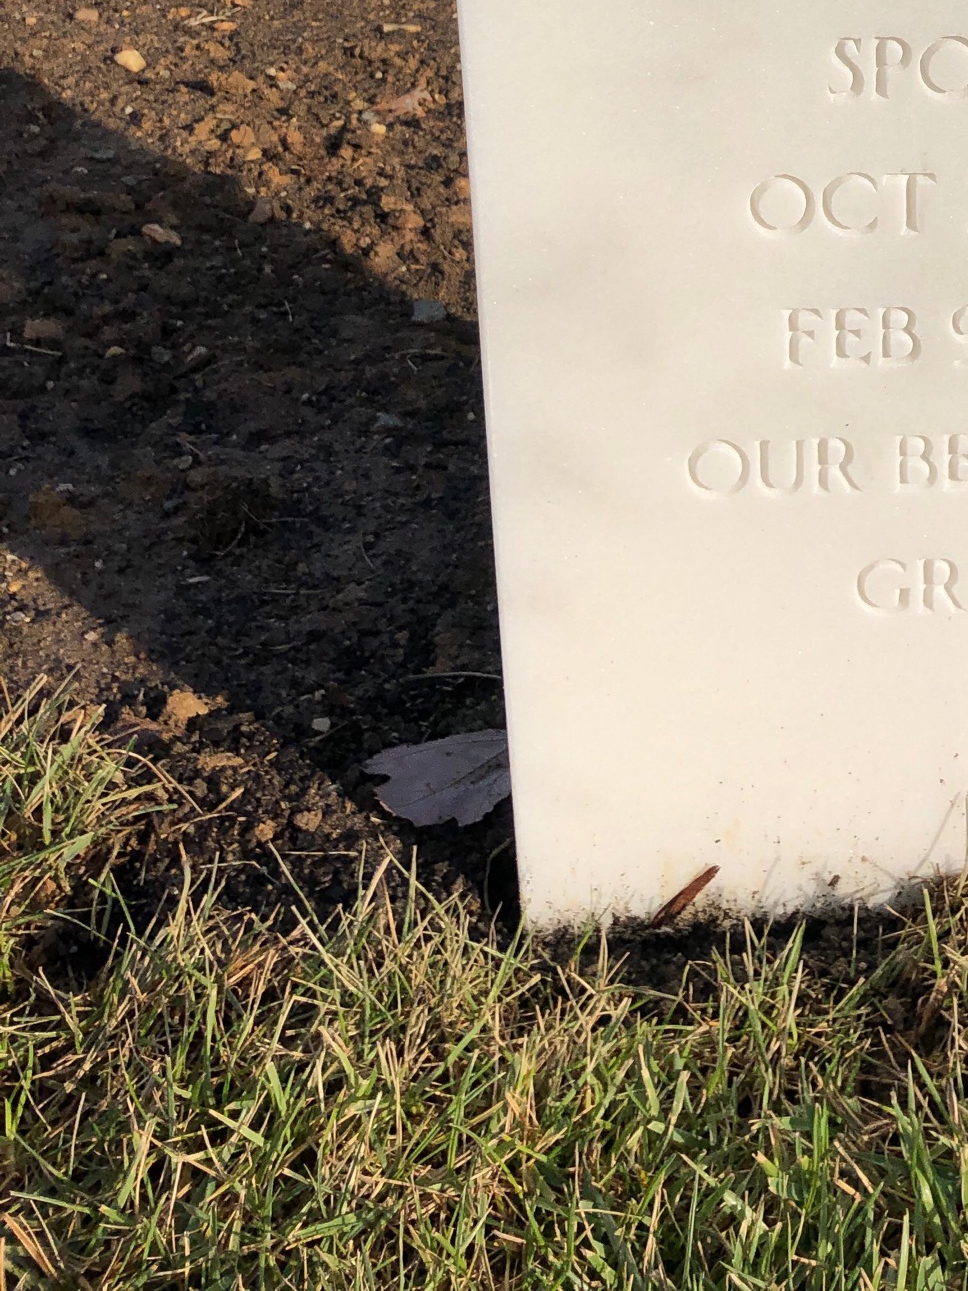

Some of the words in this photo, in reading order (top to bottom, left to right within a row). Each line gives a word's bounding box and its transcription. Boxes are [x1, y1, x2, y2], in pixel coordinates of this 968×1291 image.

[749, 171, 938, 236] OCT
[782, 305, 923, 367] FEB
[686, 436, 864, 496] OUR
